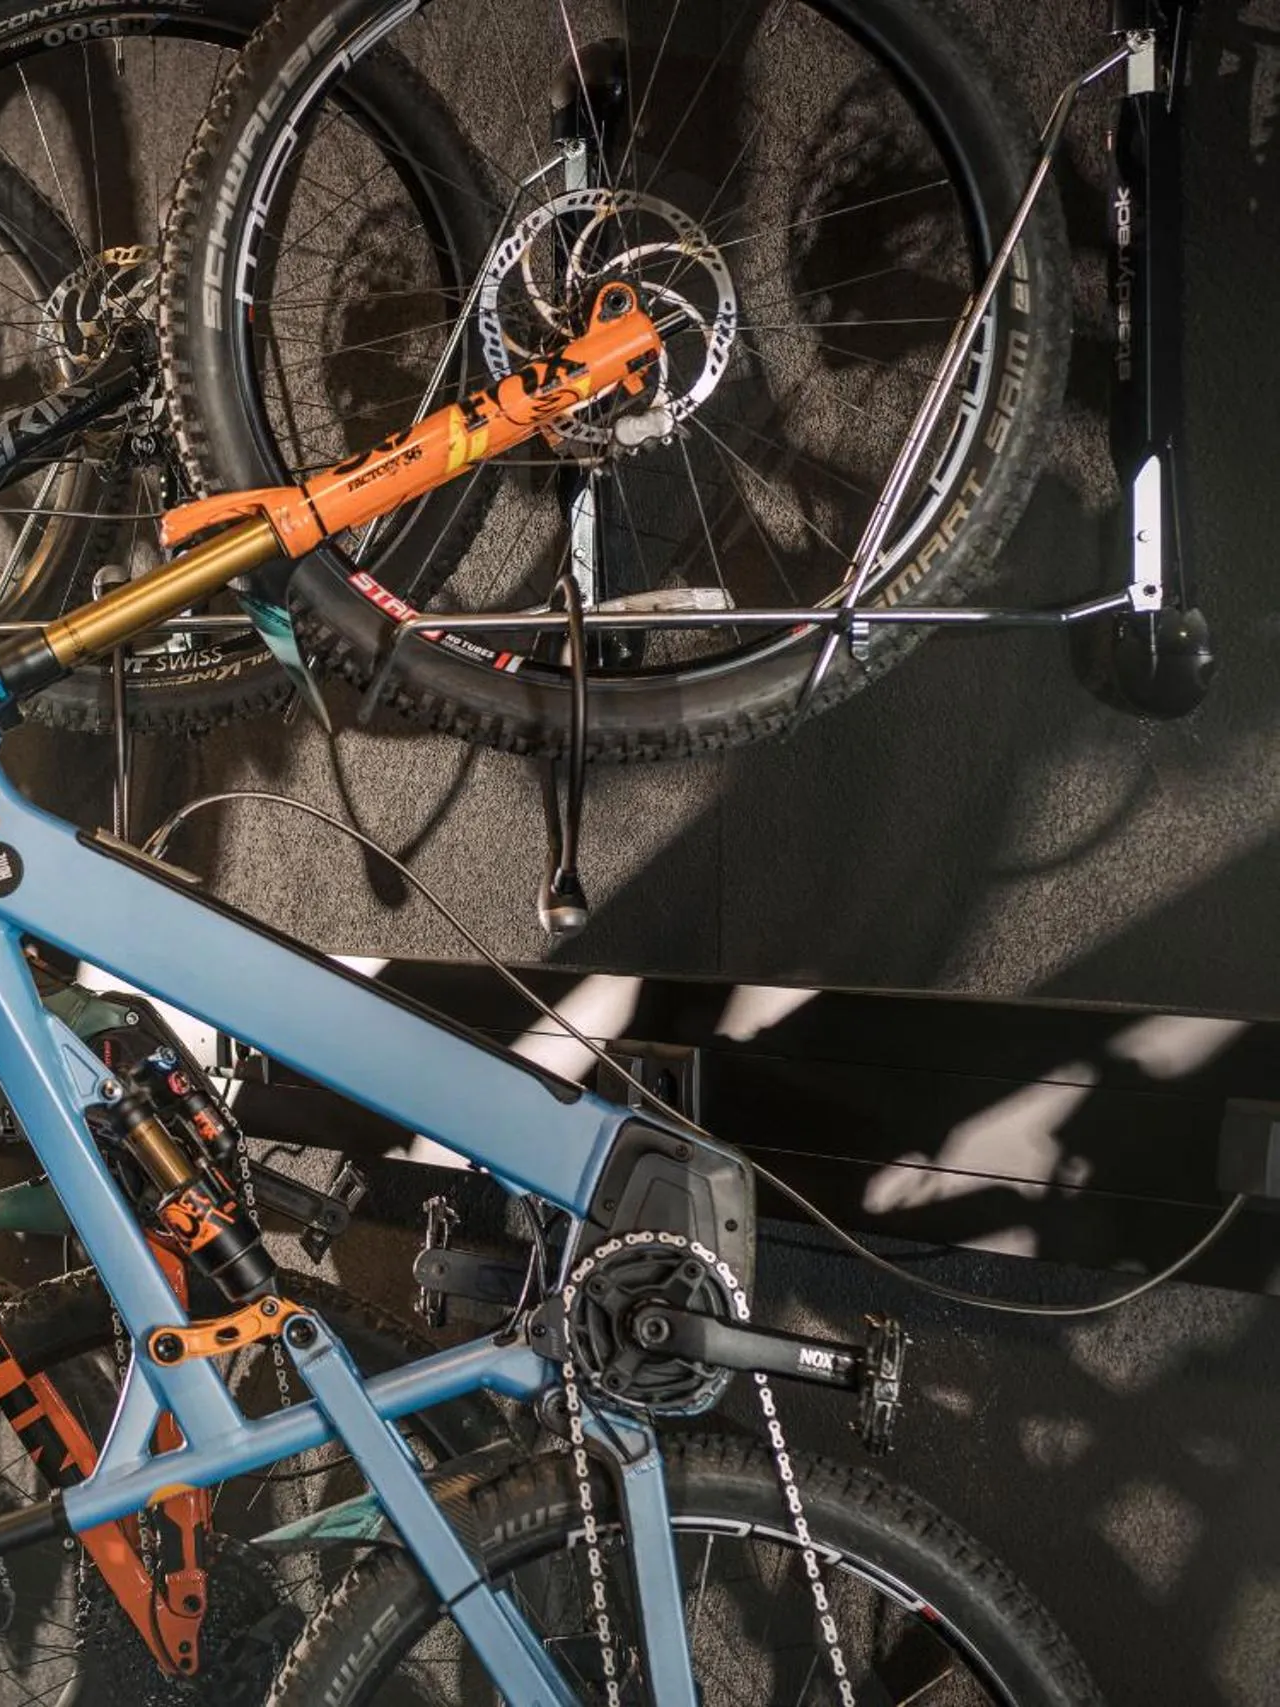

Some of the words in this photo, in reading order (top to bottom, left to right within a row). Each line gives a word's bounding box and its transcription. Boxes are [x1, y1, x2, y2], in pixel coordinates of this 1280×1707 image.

[202, 14, 338, 331] SCHWALBE
[1114, 186, 1136, 381] steadyrack
[983, 328, 1030, 453] SAM
[155, 646, 223, 673] SWISS
[799, 1347, 835, 1369] NOX
